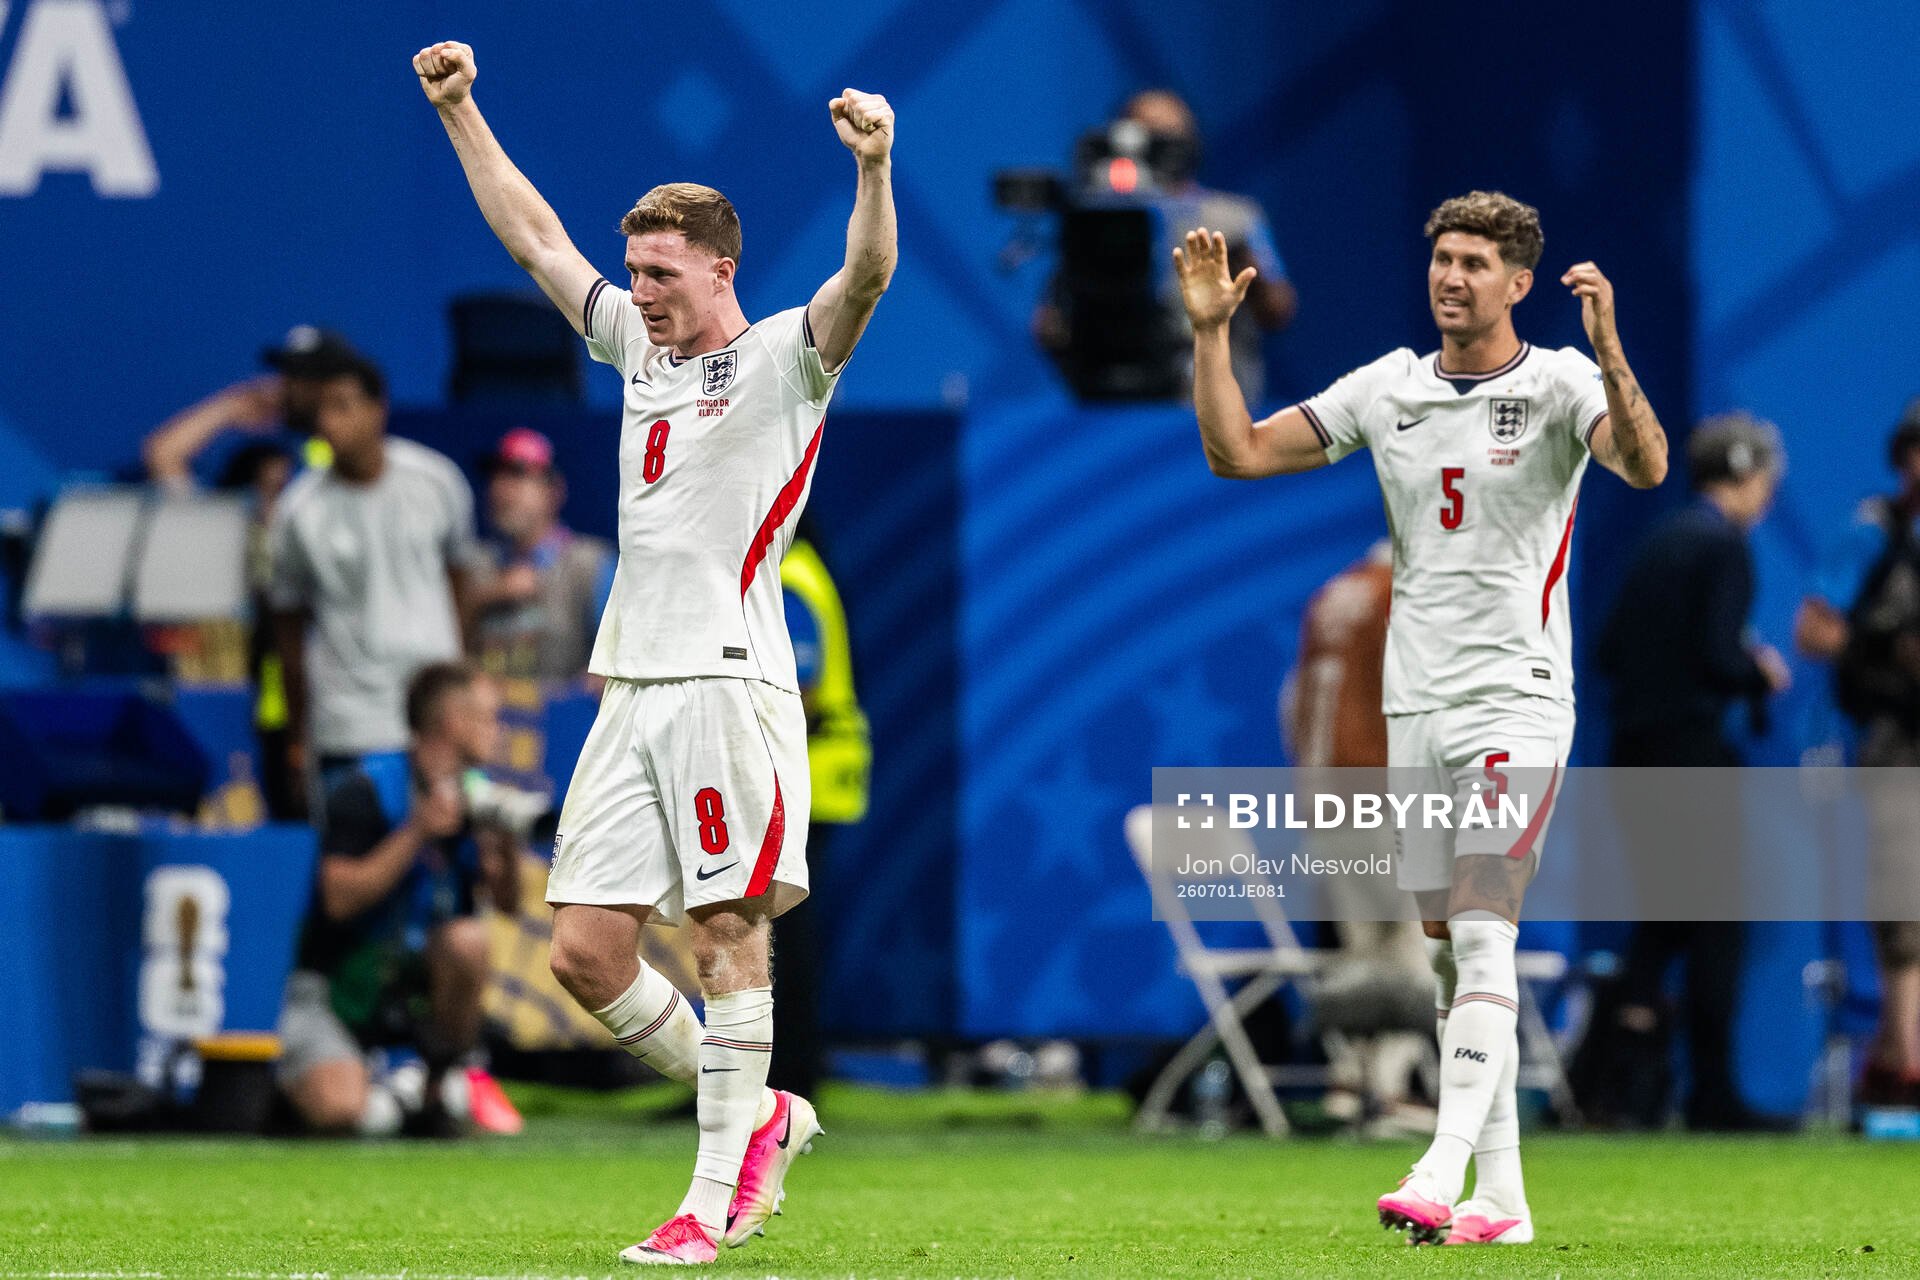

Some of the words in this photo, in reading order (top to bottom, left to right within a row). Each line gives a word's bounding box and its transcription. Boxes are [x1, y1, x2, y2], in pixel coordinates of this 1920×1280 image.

[0, 0, 161, 198] A
[696, 399, 719, 408] CONGO
[719, 398, 730, 407] DR
[643, 419, 671, 484] 8
[1440, 467, 1465, 530] 5
[1483, 751, 1510, 810] 5
[694, 786, 730, 855] 8
[1454, 1047, 1488, 1064] ENG
